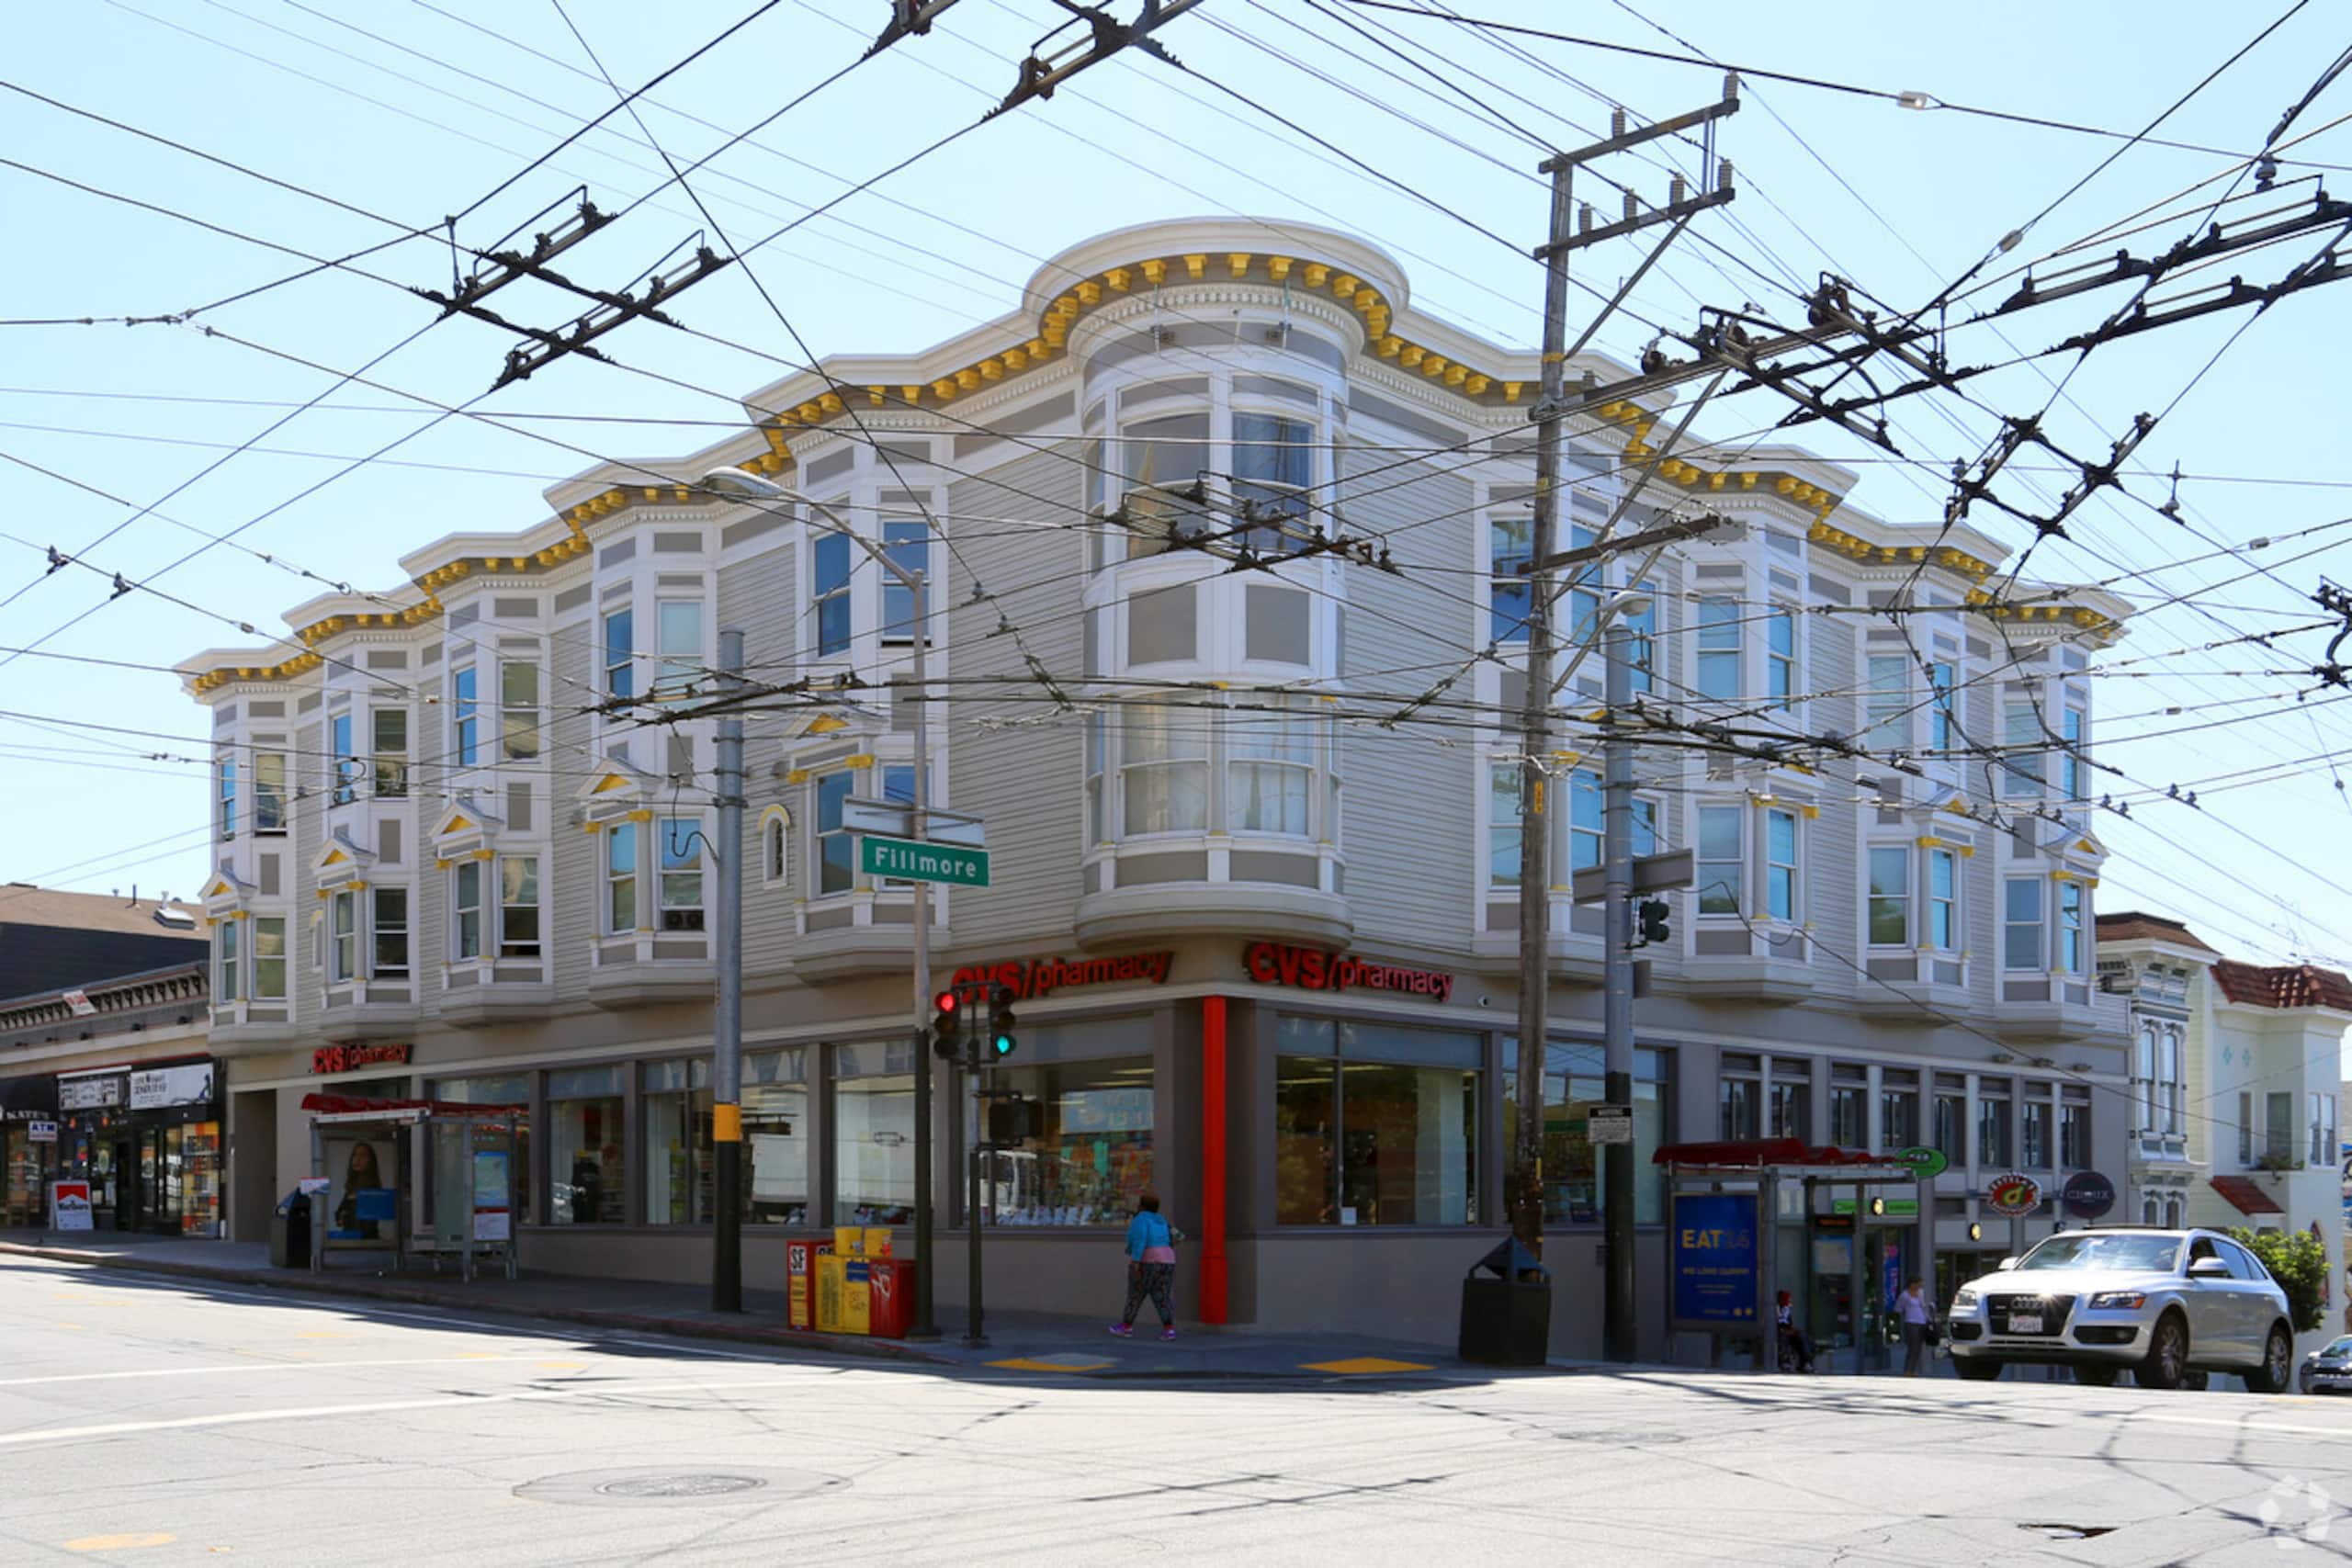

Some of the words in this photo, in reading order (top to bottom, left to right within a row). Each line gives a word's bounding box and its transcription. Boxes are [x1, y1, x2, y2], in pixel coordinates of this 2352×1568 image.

[875, 846, 977, 877] Fillmore
[952, 951, 1169, 1003] CVS/pharmacy
[1249, 941, 1455, 1002] CVS/pharmacy
[312, 1043, 408, 1074] CVS/pharmacy
[31, 1122, 55, 1132] ATM
